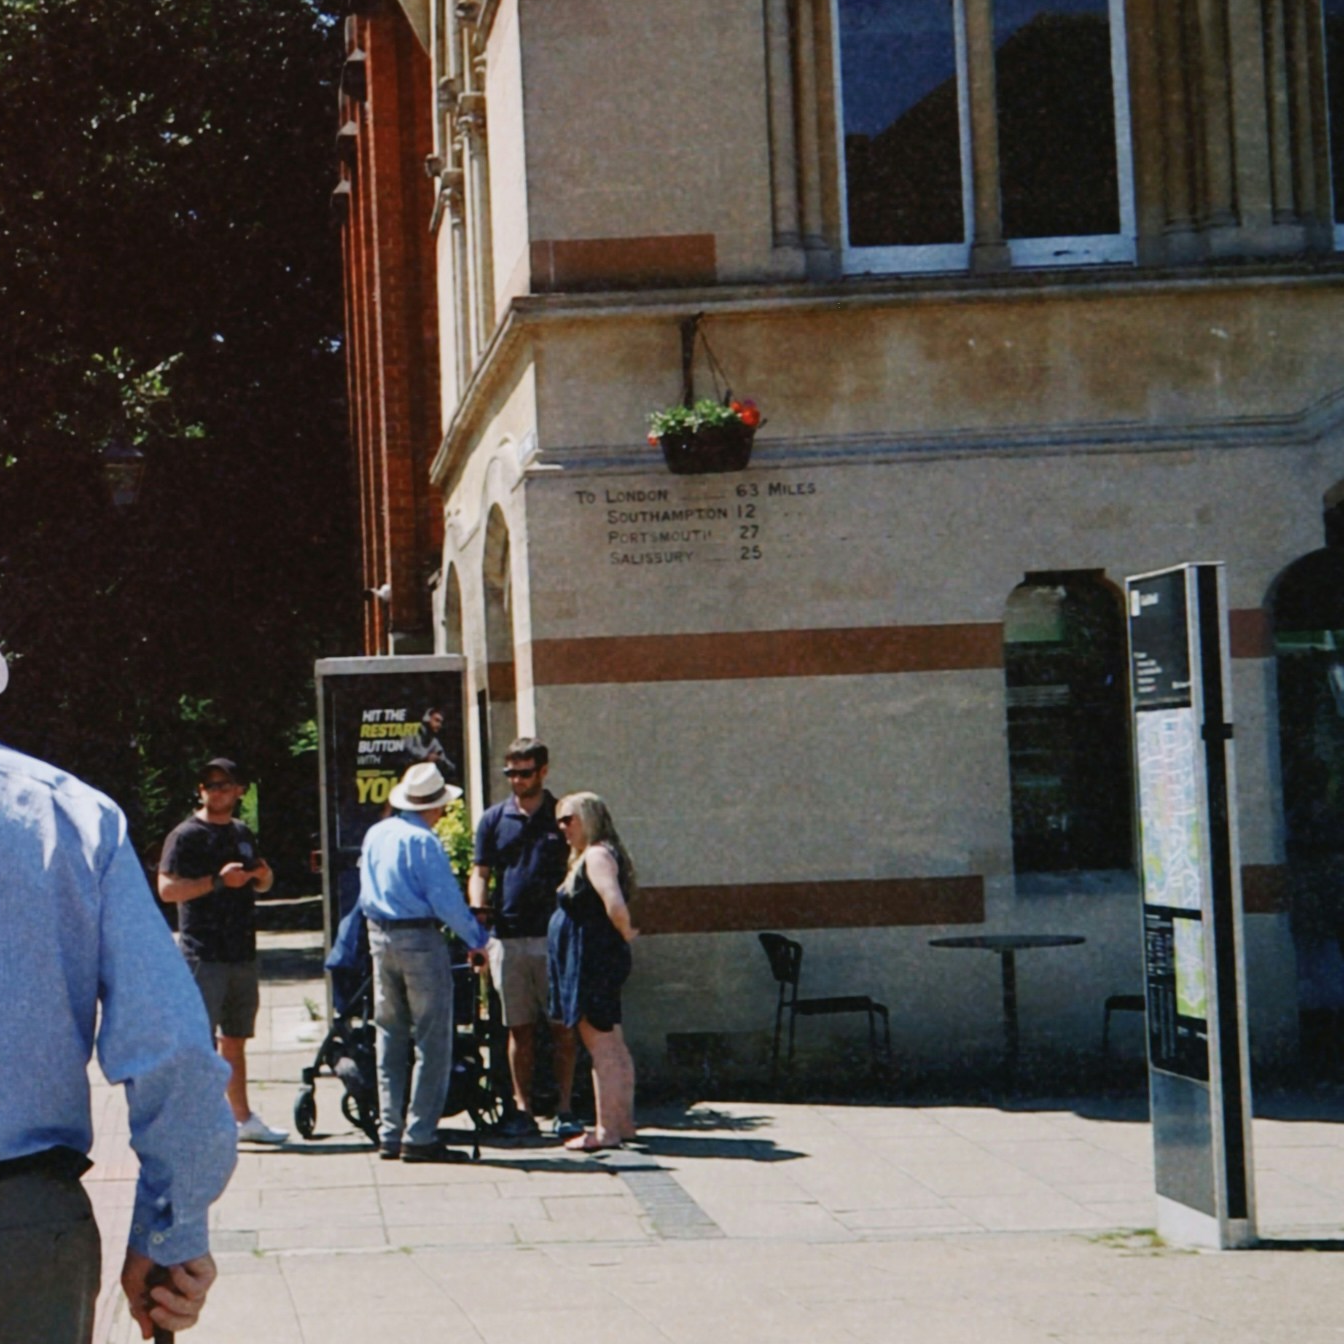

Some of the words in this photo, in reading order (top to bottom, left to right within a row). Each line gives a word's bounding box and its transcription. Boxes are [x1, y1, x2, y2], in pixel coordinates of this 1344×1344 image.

[574, 490, 596, 504] TO
[605, 489, 669, 503] LONDON
[736, 482, 759, 497] 63
[768, 481, 816, 496] MILES
[608, 508, 728, 524] SOUTHAMPTON
[737, 503, 756, 518] 12
[608, 529, 712, 544] PORTSMOUTH
[740, 524, 759, 539] 27
[610, 550, 694, 565] SALISBURY
[740, 544, 762, 560] 25
[362, 709, 383, 722] HIT
[384, 709, 407, 722] THE
[360, 723, 422, 738] RESTART
[358, 740, 405, 753] BUTTON
